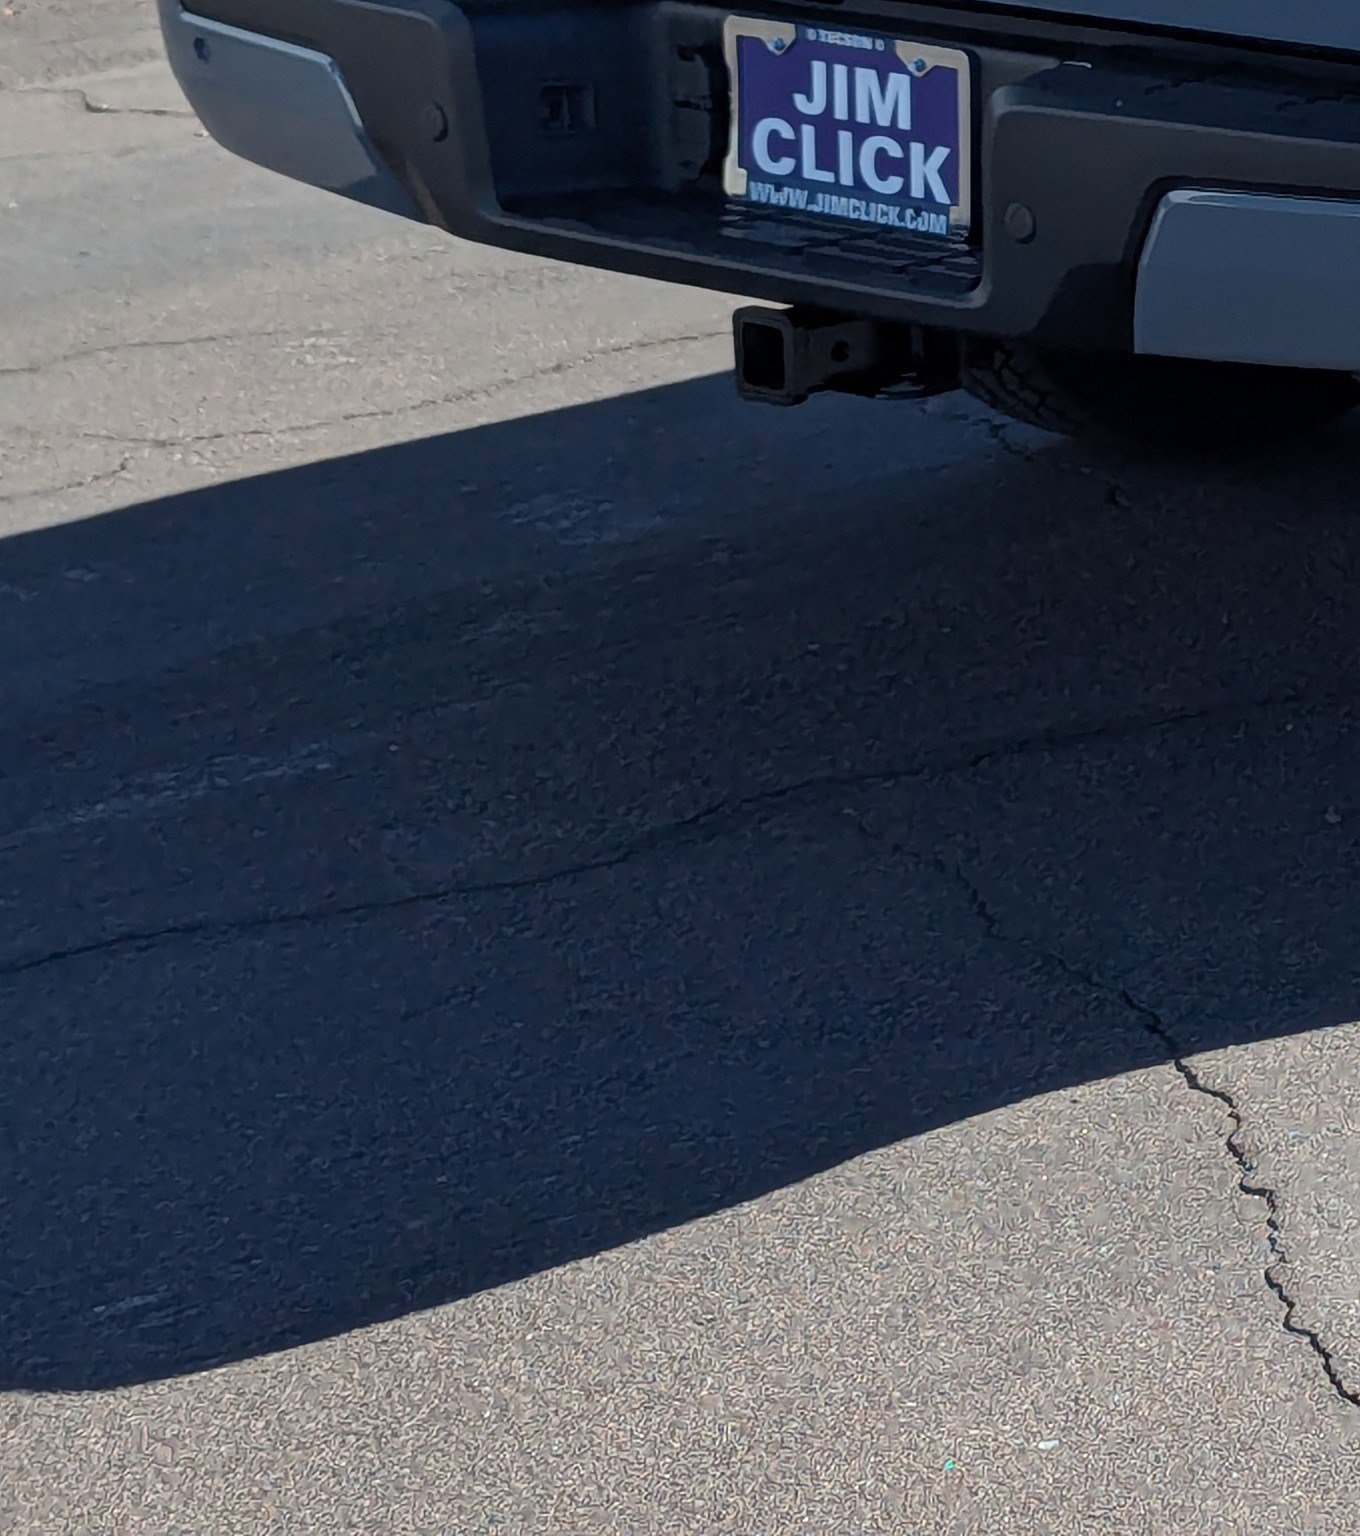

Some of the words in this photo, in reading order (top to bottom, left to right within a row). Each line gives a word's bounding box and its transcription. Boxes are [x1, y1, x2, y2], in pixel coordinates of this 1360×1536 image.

[793, 60, 911, 131] JIM
[752, 117, 951, 205] CLICK
[750, 181, 948, 235] WWW.JIMCLICK.COM
